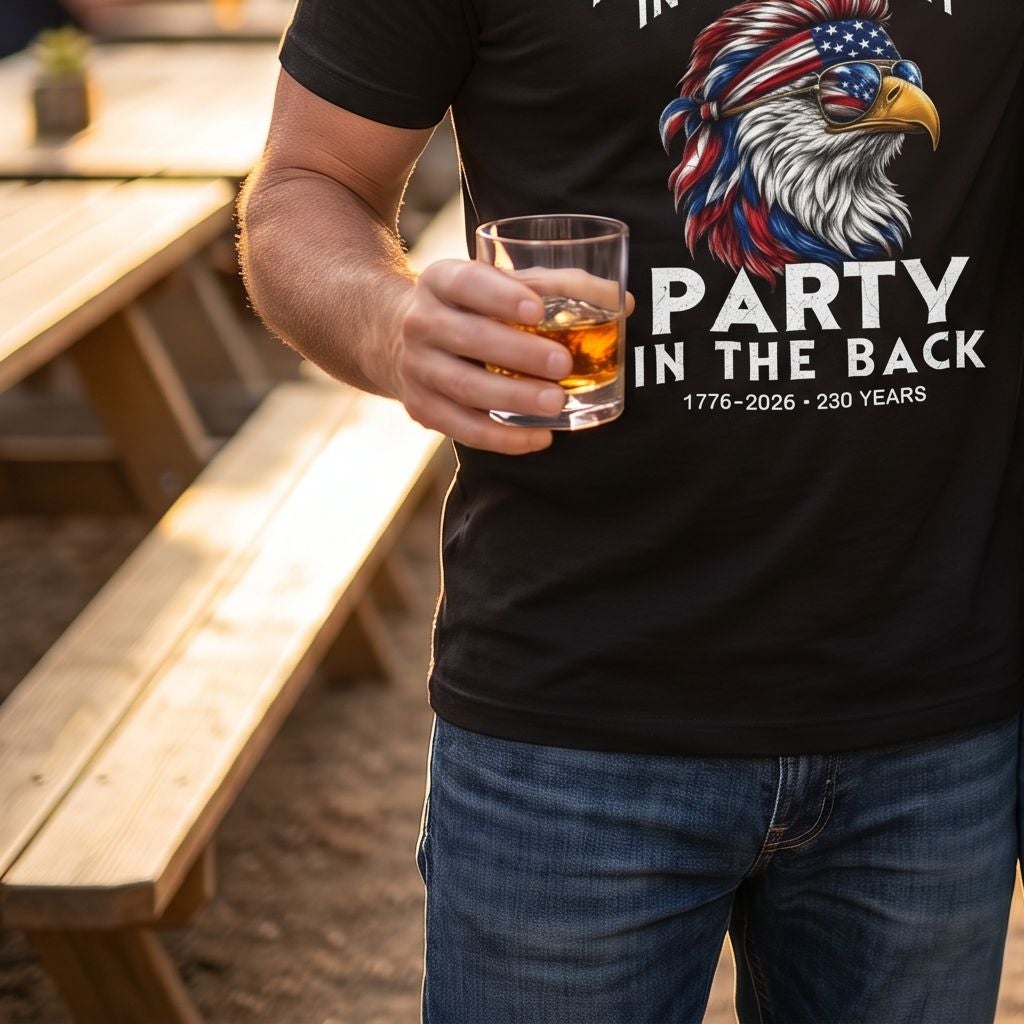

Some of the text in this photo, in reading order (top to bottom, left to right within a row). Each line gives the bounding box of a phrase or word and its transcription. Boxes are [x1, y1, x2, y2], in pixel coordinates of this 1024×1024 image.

[650, 256, 970, 336] PARTY
[634, 329, 986, 388] IN THE BACK
[683, 385, 927, 411] 1776-2026 230 YEARS
